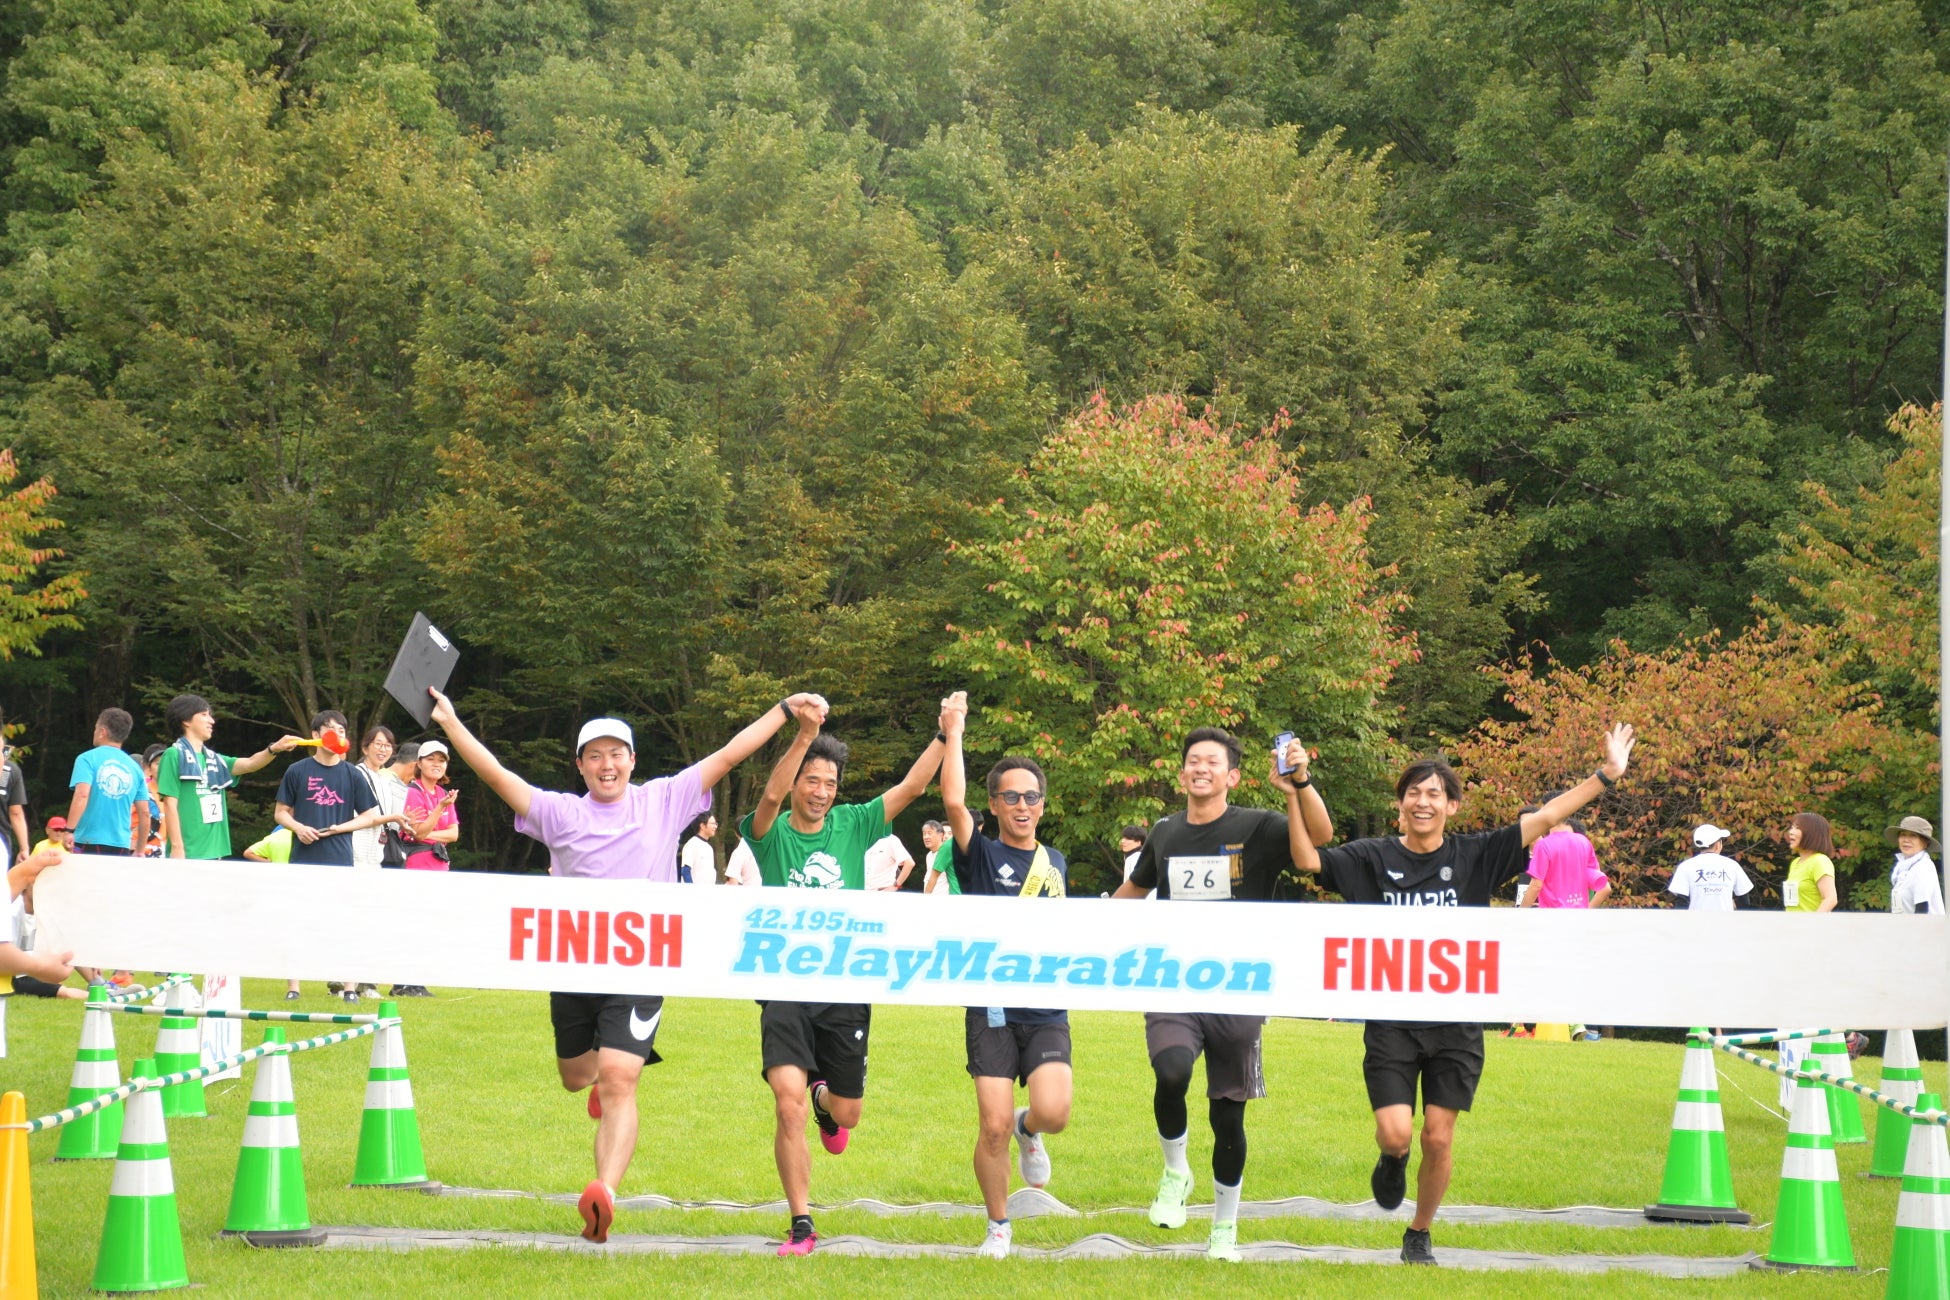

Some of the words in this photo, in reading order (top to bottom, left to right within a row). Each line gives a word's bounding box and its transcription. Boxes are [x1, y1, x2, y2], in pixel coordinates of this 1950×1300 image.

[210, 803, 218, 816] 2
[1183, 869, 1215, 889] 26
[509, 907, 683, 968] FINISH
[745, 907, 884, 933] 42.195km
[732, 931, 1272, 992] RelayMarathon
[1323, 937, 1500, 994] FINISH
